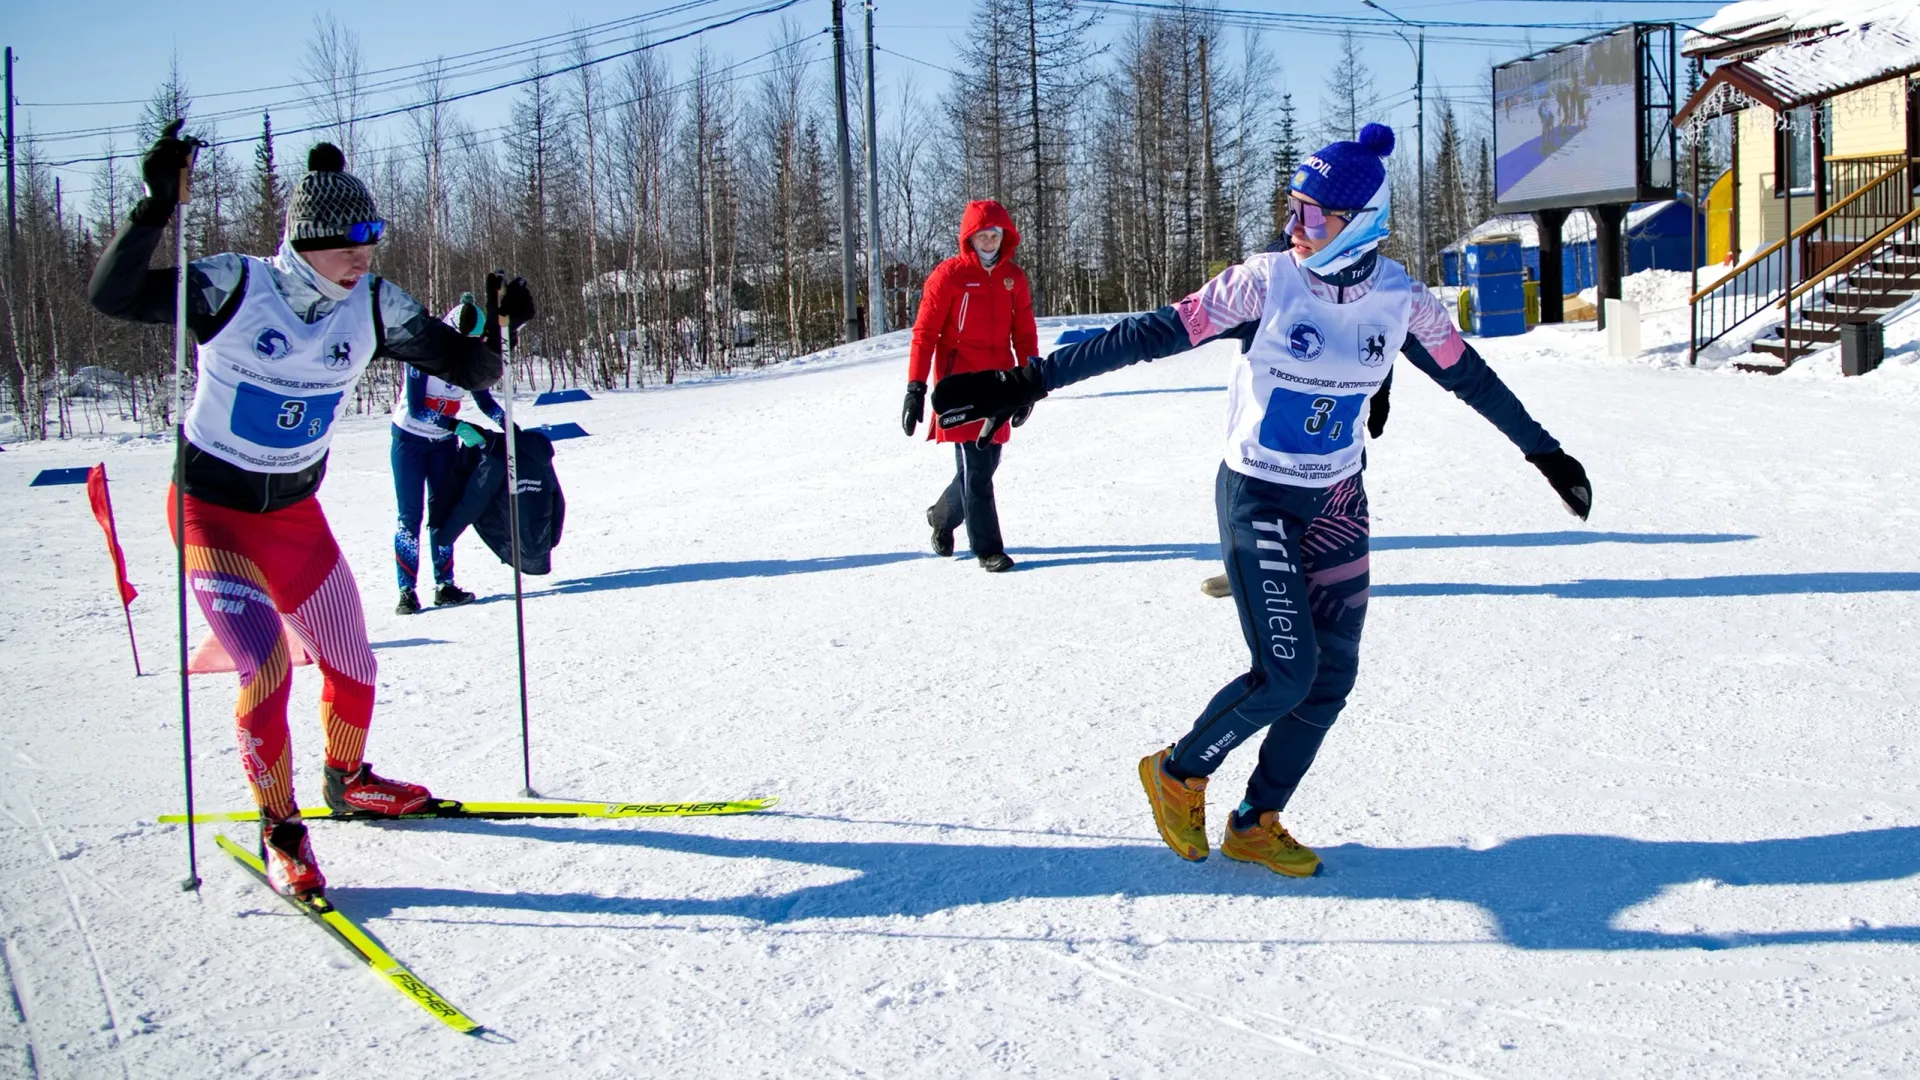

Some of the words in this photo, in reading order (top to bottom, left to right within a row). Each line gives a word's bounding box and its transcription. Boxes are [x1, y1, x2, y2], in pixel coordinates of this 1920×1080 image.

[1276, 370, 1337, 388] ВСЕРОССИЙСКИЕ
[277, 400, 307, 430] 3
[308, 418, 321, 437] 3
[1304, 397, 1336, 435] 3
[1329, 421, 1342, 441] 4
[212, 597, 246, 615] КРАЙ
[1215, 730, 1235, 747] SPORT
[350, 791, 396, 803] alpina
[619, 802, 728, 814] FISCHER
[392, 973, 457, 1017] FISCHER
